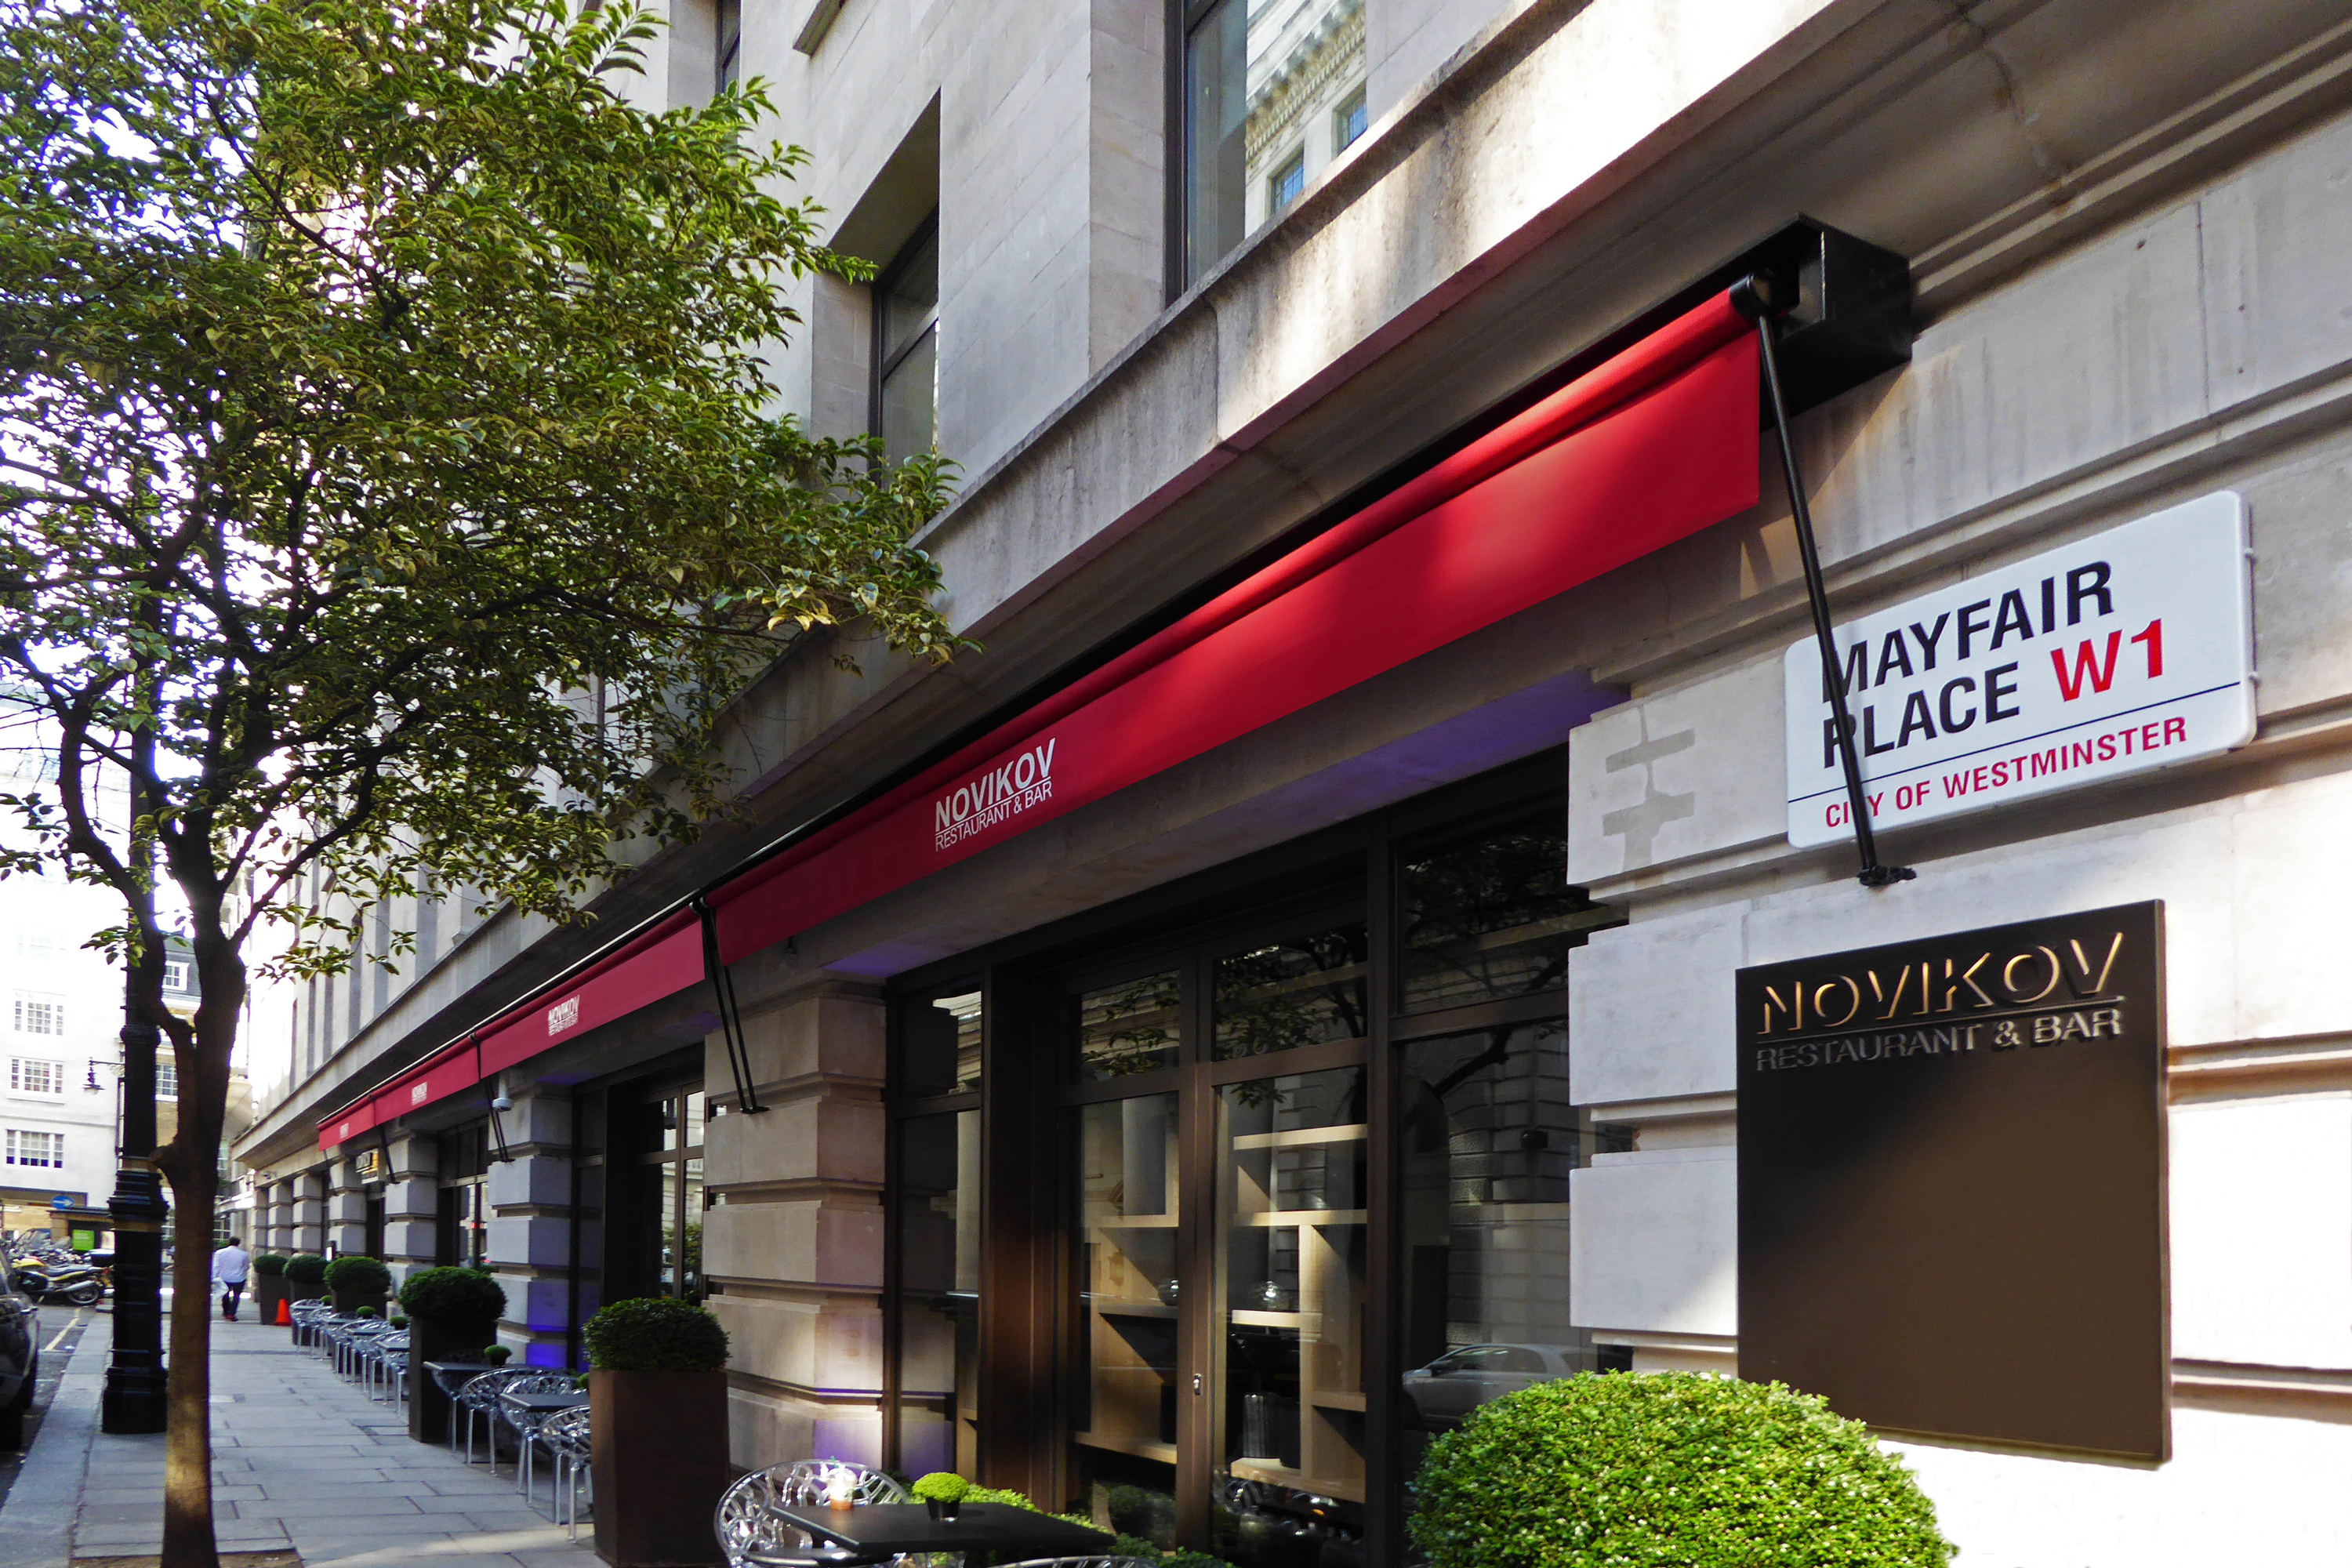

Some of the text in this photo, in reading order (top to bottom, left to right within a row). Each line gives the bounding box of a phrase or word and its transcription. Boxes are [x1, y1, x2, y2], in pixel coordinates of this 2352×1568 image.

[1822, 561, 2114, 704] MAYFAIR
[1823, 618, 2164, 769] PLACE W1
[935, 737, 1056, 833] NOVIKOV
[935, 781, 1053, 852] RESTAURANT & BAR
[1825, 716, 2187, 828] CIY OF WESTMINSTER
[1756, 931, 2124, 1036] NOVIKOV
[1755, 1007, 2124, 1072] RESTAURANT & BAR
